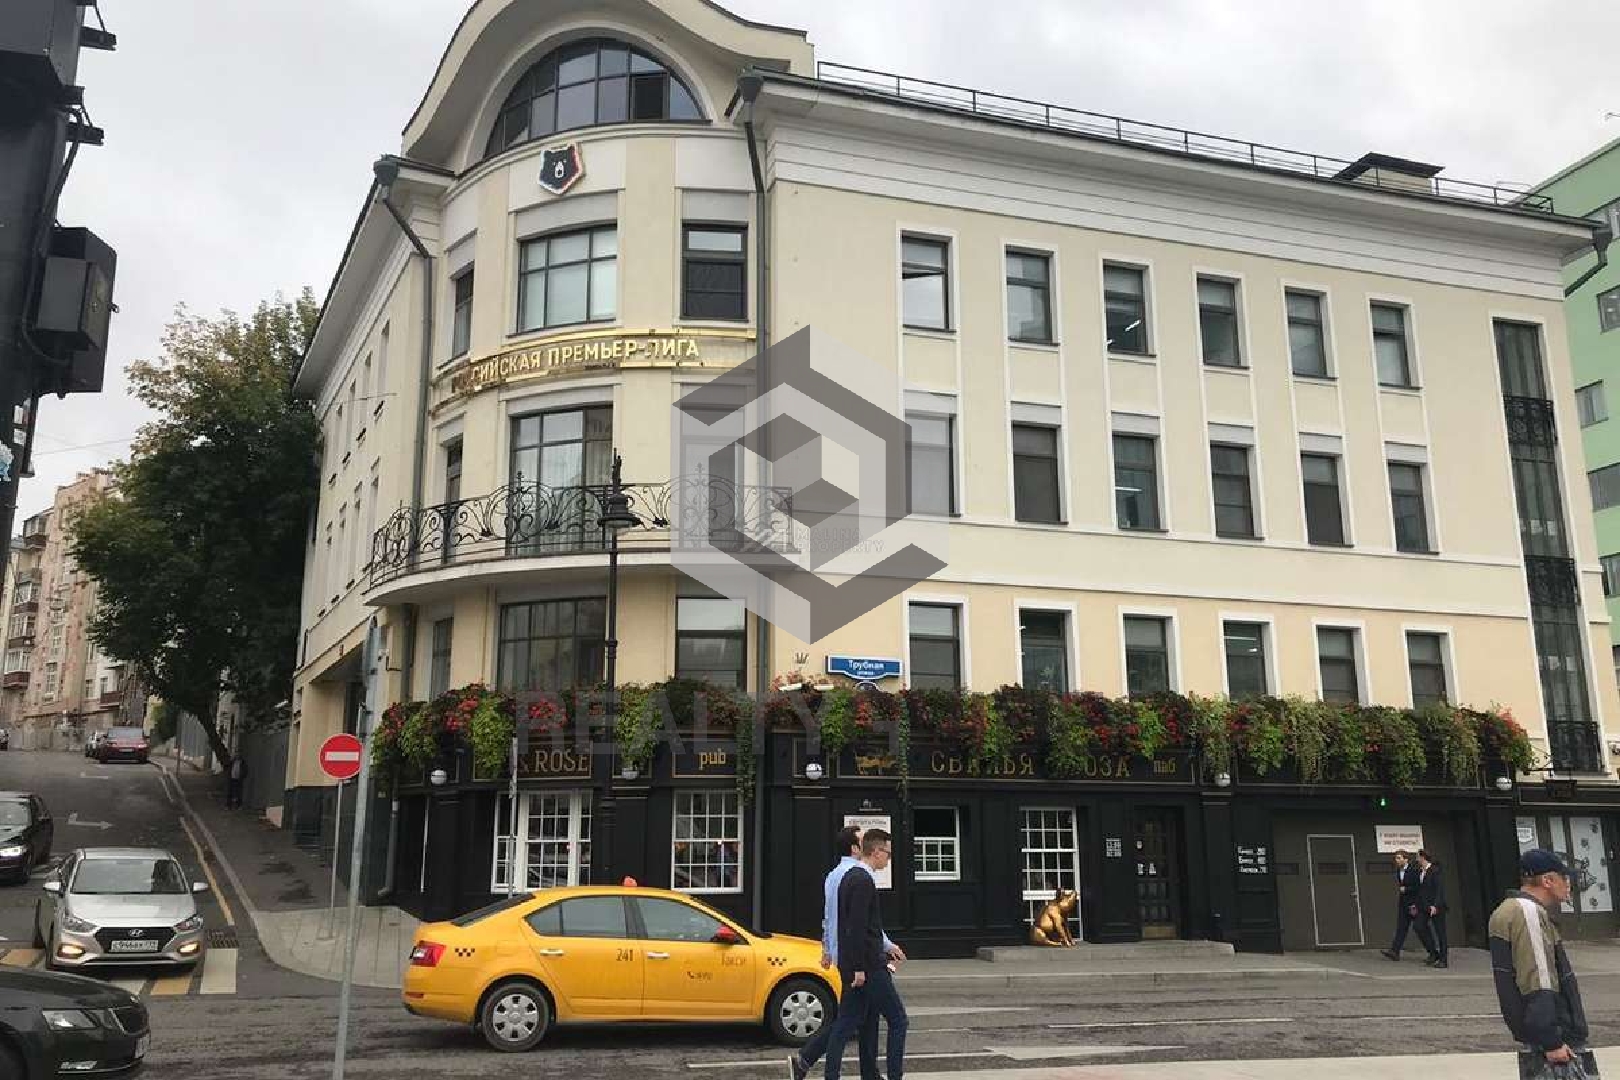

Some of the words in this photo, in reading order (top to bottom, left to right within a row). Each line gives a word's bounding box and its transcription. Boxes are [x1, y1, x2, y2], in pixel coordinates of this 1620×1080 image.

[548, 338, 700, 366] ПРЕМЬЕР-ЛИГА
[535, 748, 588, 772] ROSE
[698, 747, 726, 771] pub
[1072, 755, 1131, 777] ОЗА
[615, 948, 634, 962] 241
